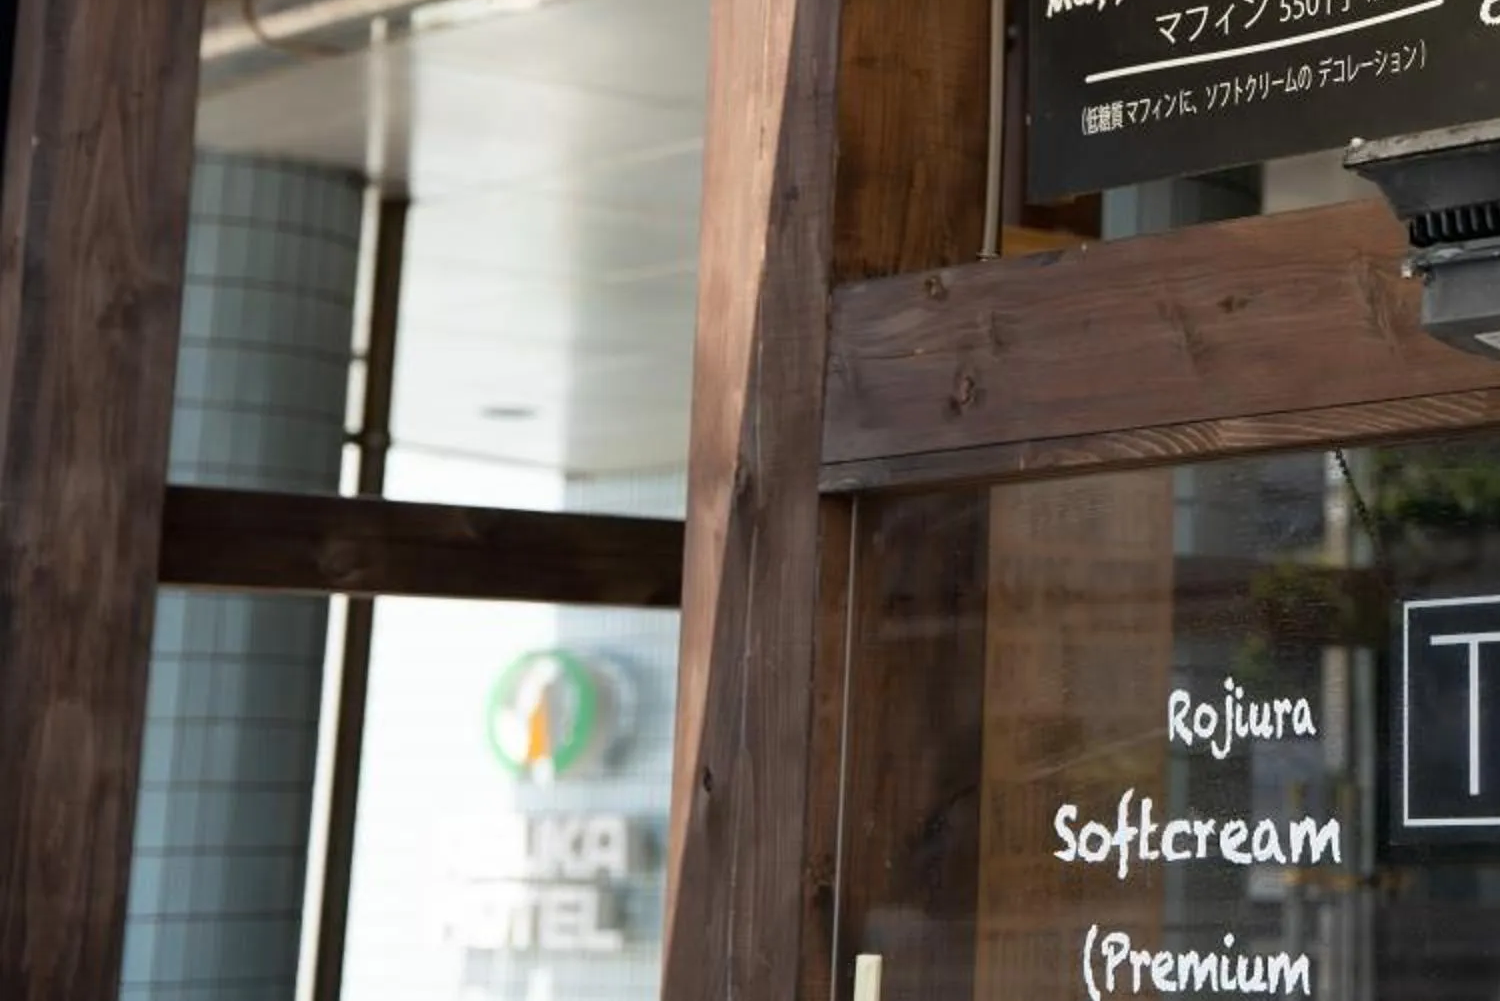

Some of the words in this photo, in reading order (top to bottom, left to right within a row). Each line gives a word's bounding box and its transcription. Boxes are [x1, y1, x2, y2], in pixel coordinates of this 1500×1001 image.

[1168, 676, 1317, 759] Rojiura
[1053, 787, 1342, 880] Softcream
[1083, 923, 1311, 1001] (Premium
